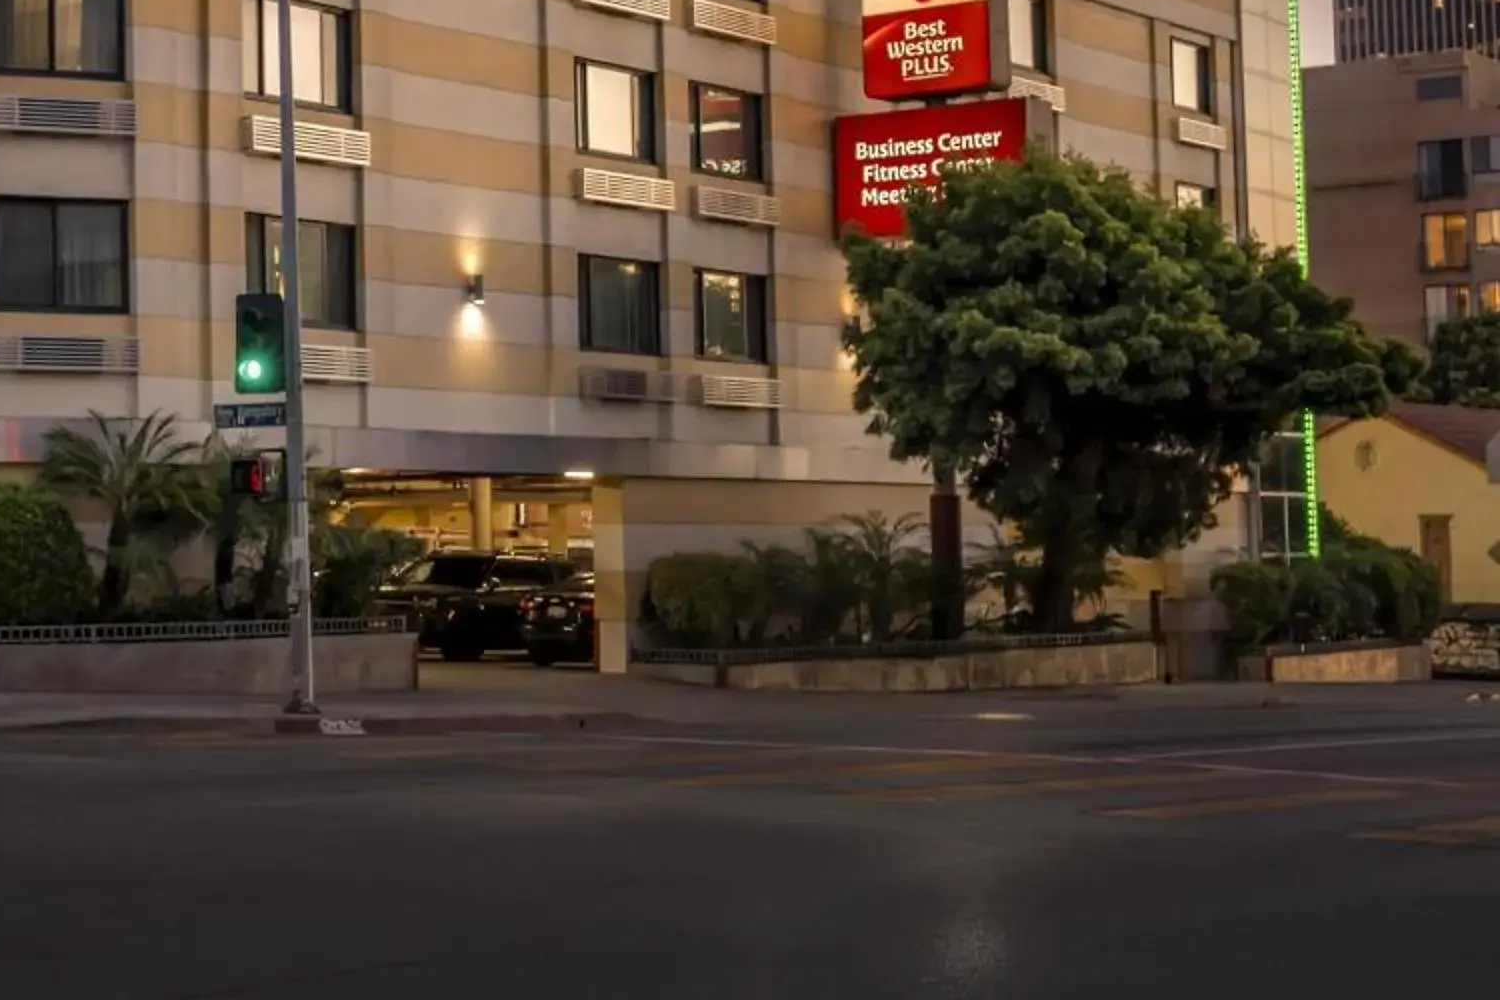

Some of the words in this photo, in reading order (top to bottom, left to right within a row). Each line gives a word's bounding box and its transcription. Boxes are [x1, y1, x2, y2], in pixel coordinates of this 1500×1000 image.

[904, 19, 946, 40] Best
[887, 36, 964, 60] Western
[901, 54, 950, 77] PLUS
[855, 138, 933, 160] Business
[938, 131, 1002, 152] Center
[863, 162, 927, 184] Fitness
[861, 183, 938, 208] Meet
